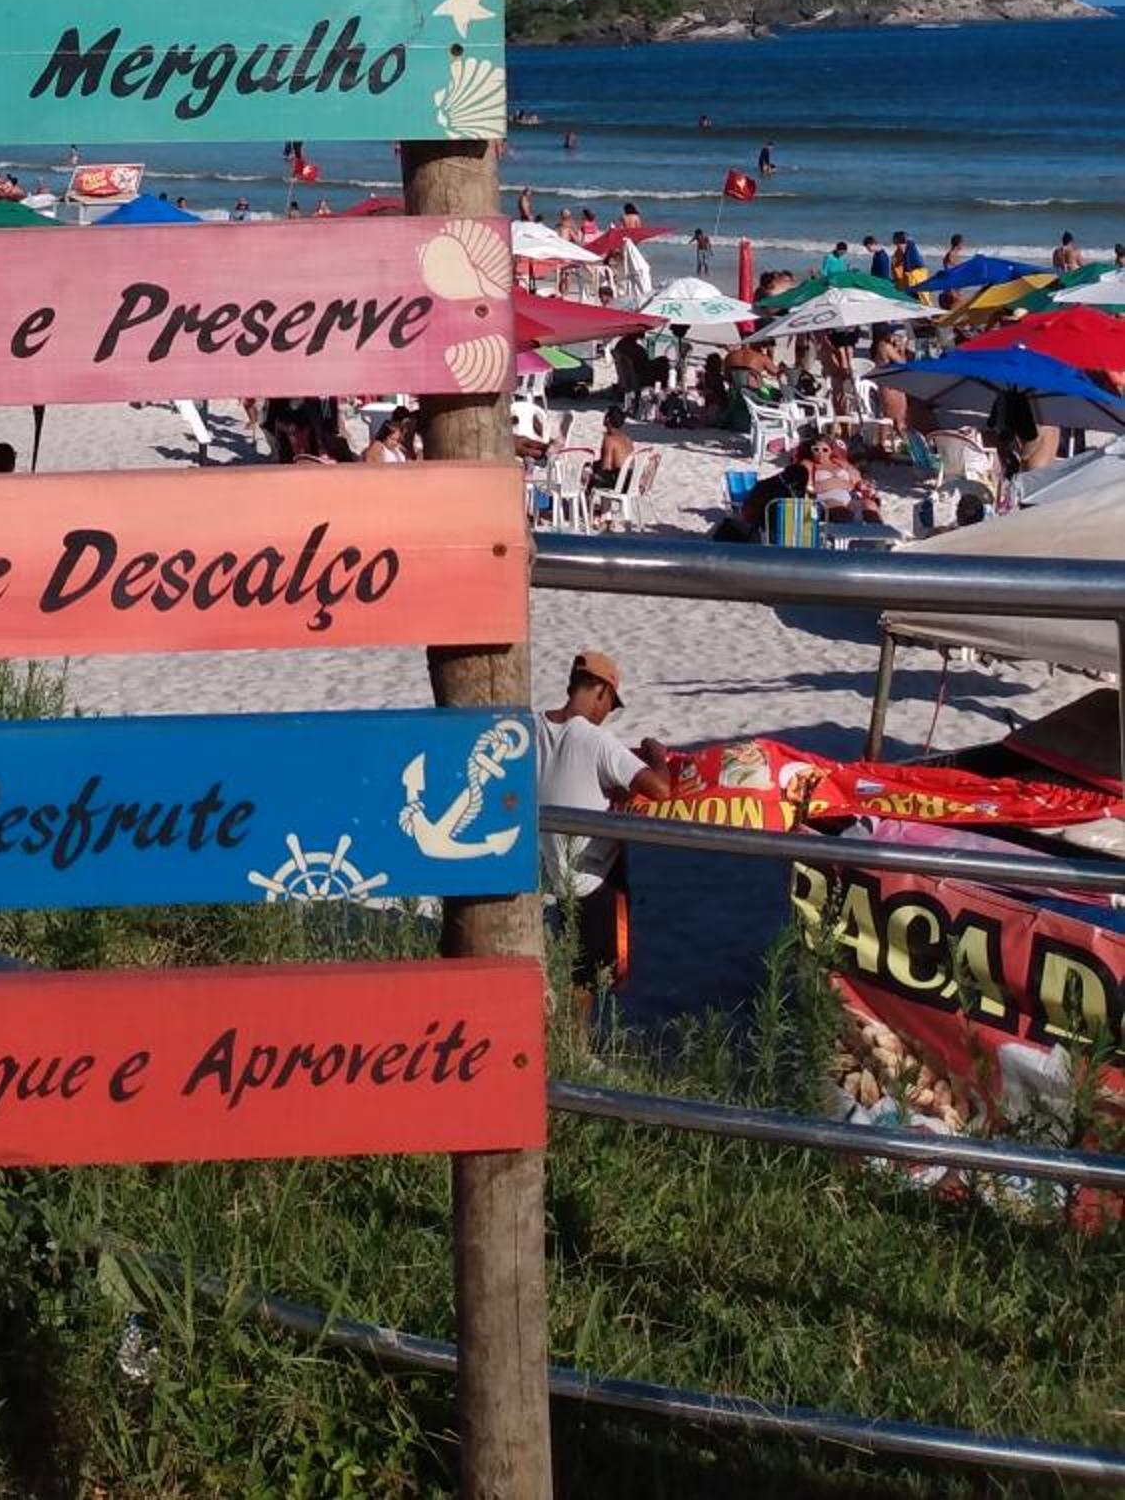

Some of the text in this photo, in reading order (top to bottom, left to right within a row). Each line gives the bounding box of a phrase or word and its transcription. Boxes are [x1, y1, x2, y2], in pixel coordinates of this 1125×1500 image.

[29, 14, 409, 122] Mergulho
[10, 305, 57, 360] e
[92, 281, 435, 363] Preserve
[37, 521, 401, 631] Descalço
[108, 1049, 151, 1102] e
[181, 1019, 493, 1108] Aproveite
